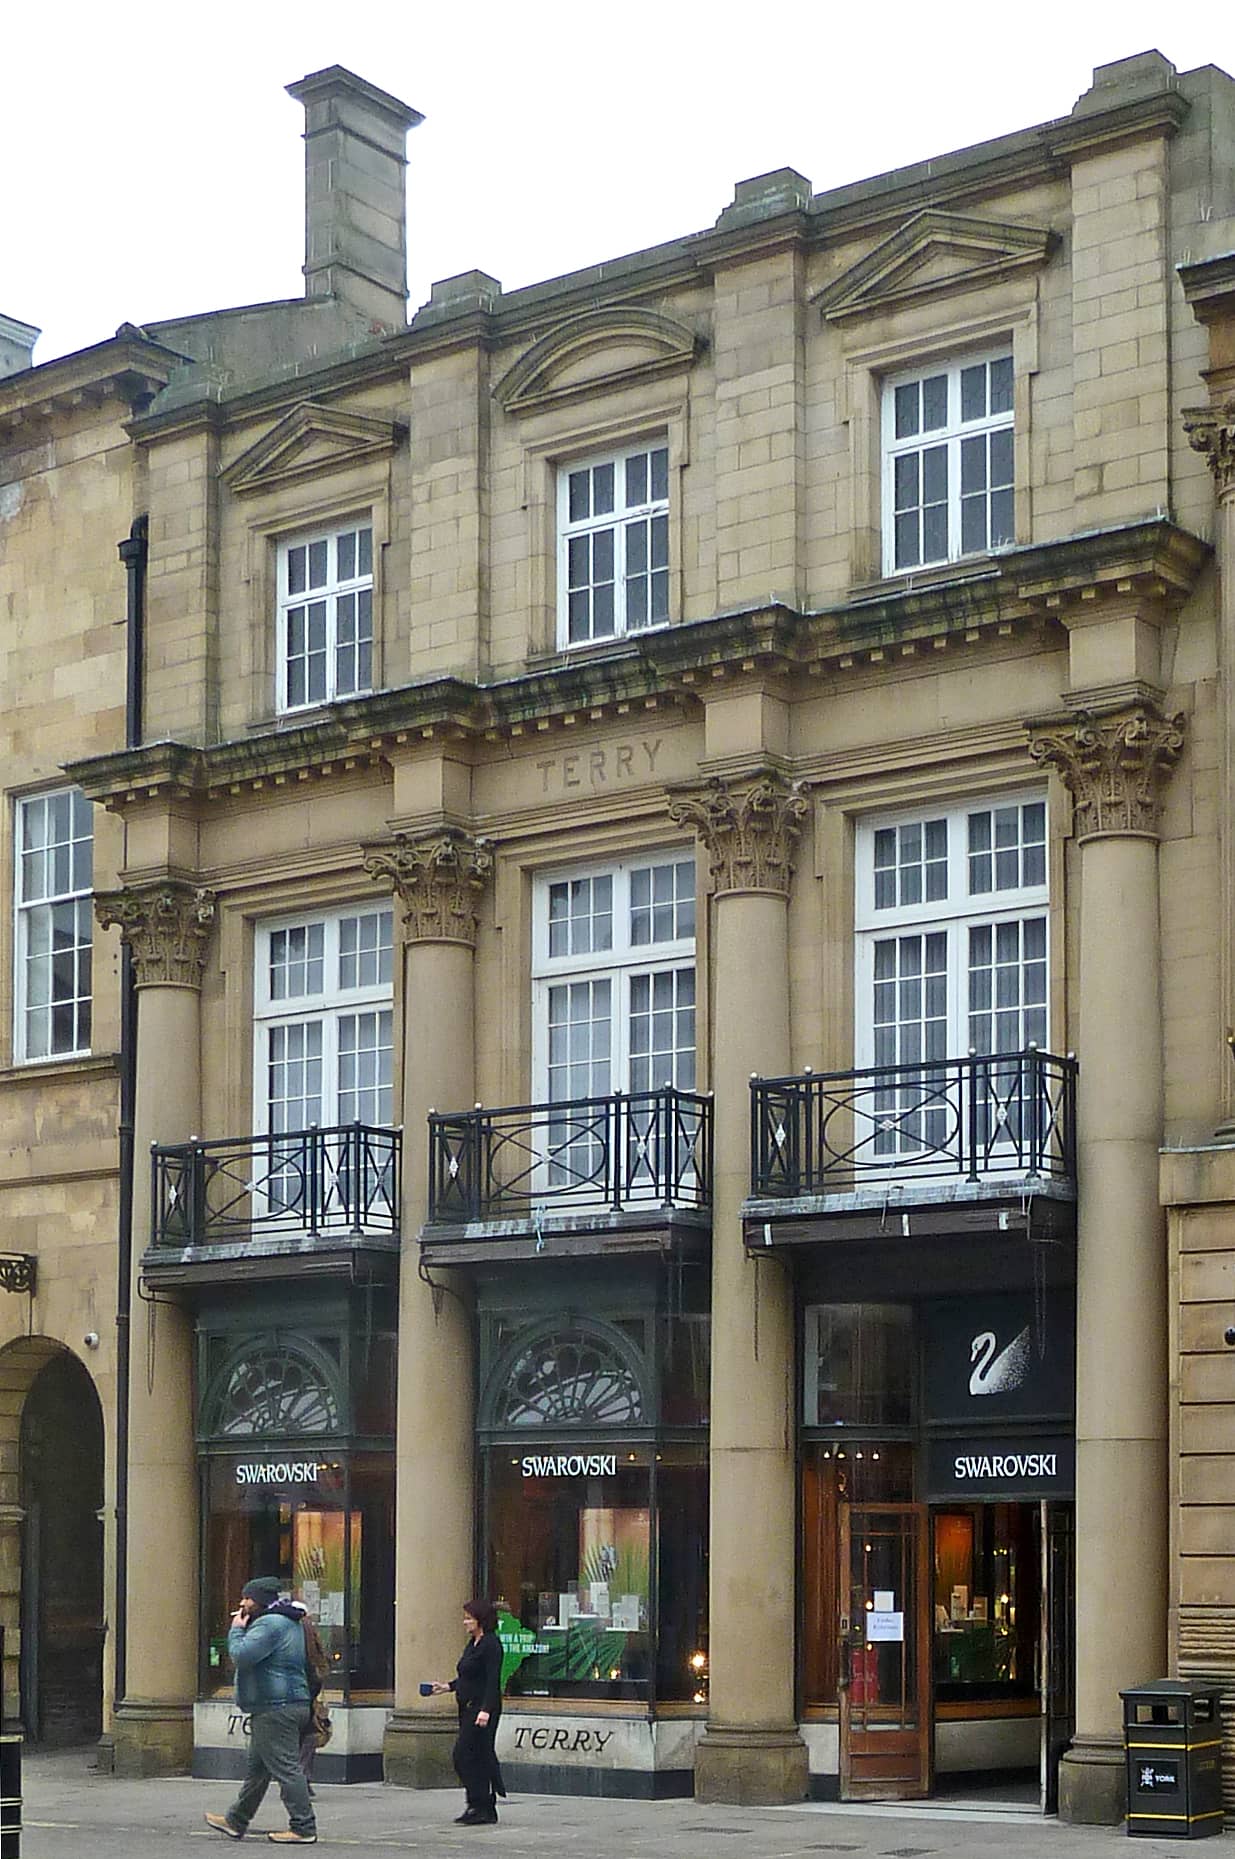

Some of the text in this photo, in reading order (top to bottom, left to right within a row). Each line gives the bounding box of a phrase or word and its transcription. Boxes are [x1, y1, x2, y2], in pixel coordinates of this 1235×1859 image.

[536, 739, 663, 792] TERRY
[236, 1462, 318, 1483] SWAROVSKI
[522, 1455, 616, 1477] SWAROVSKI
[954, 1454, 1057, 1478] SWAROVSKI
[514, 1727, 615, 1752] TERRY
[1154, 1775, 1176, 1783] YORK
